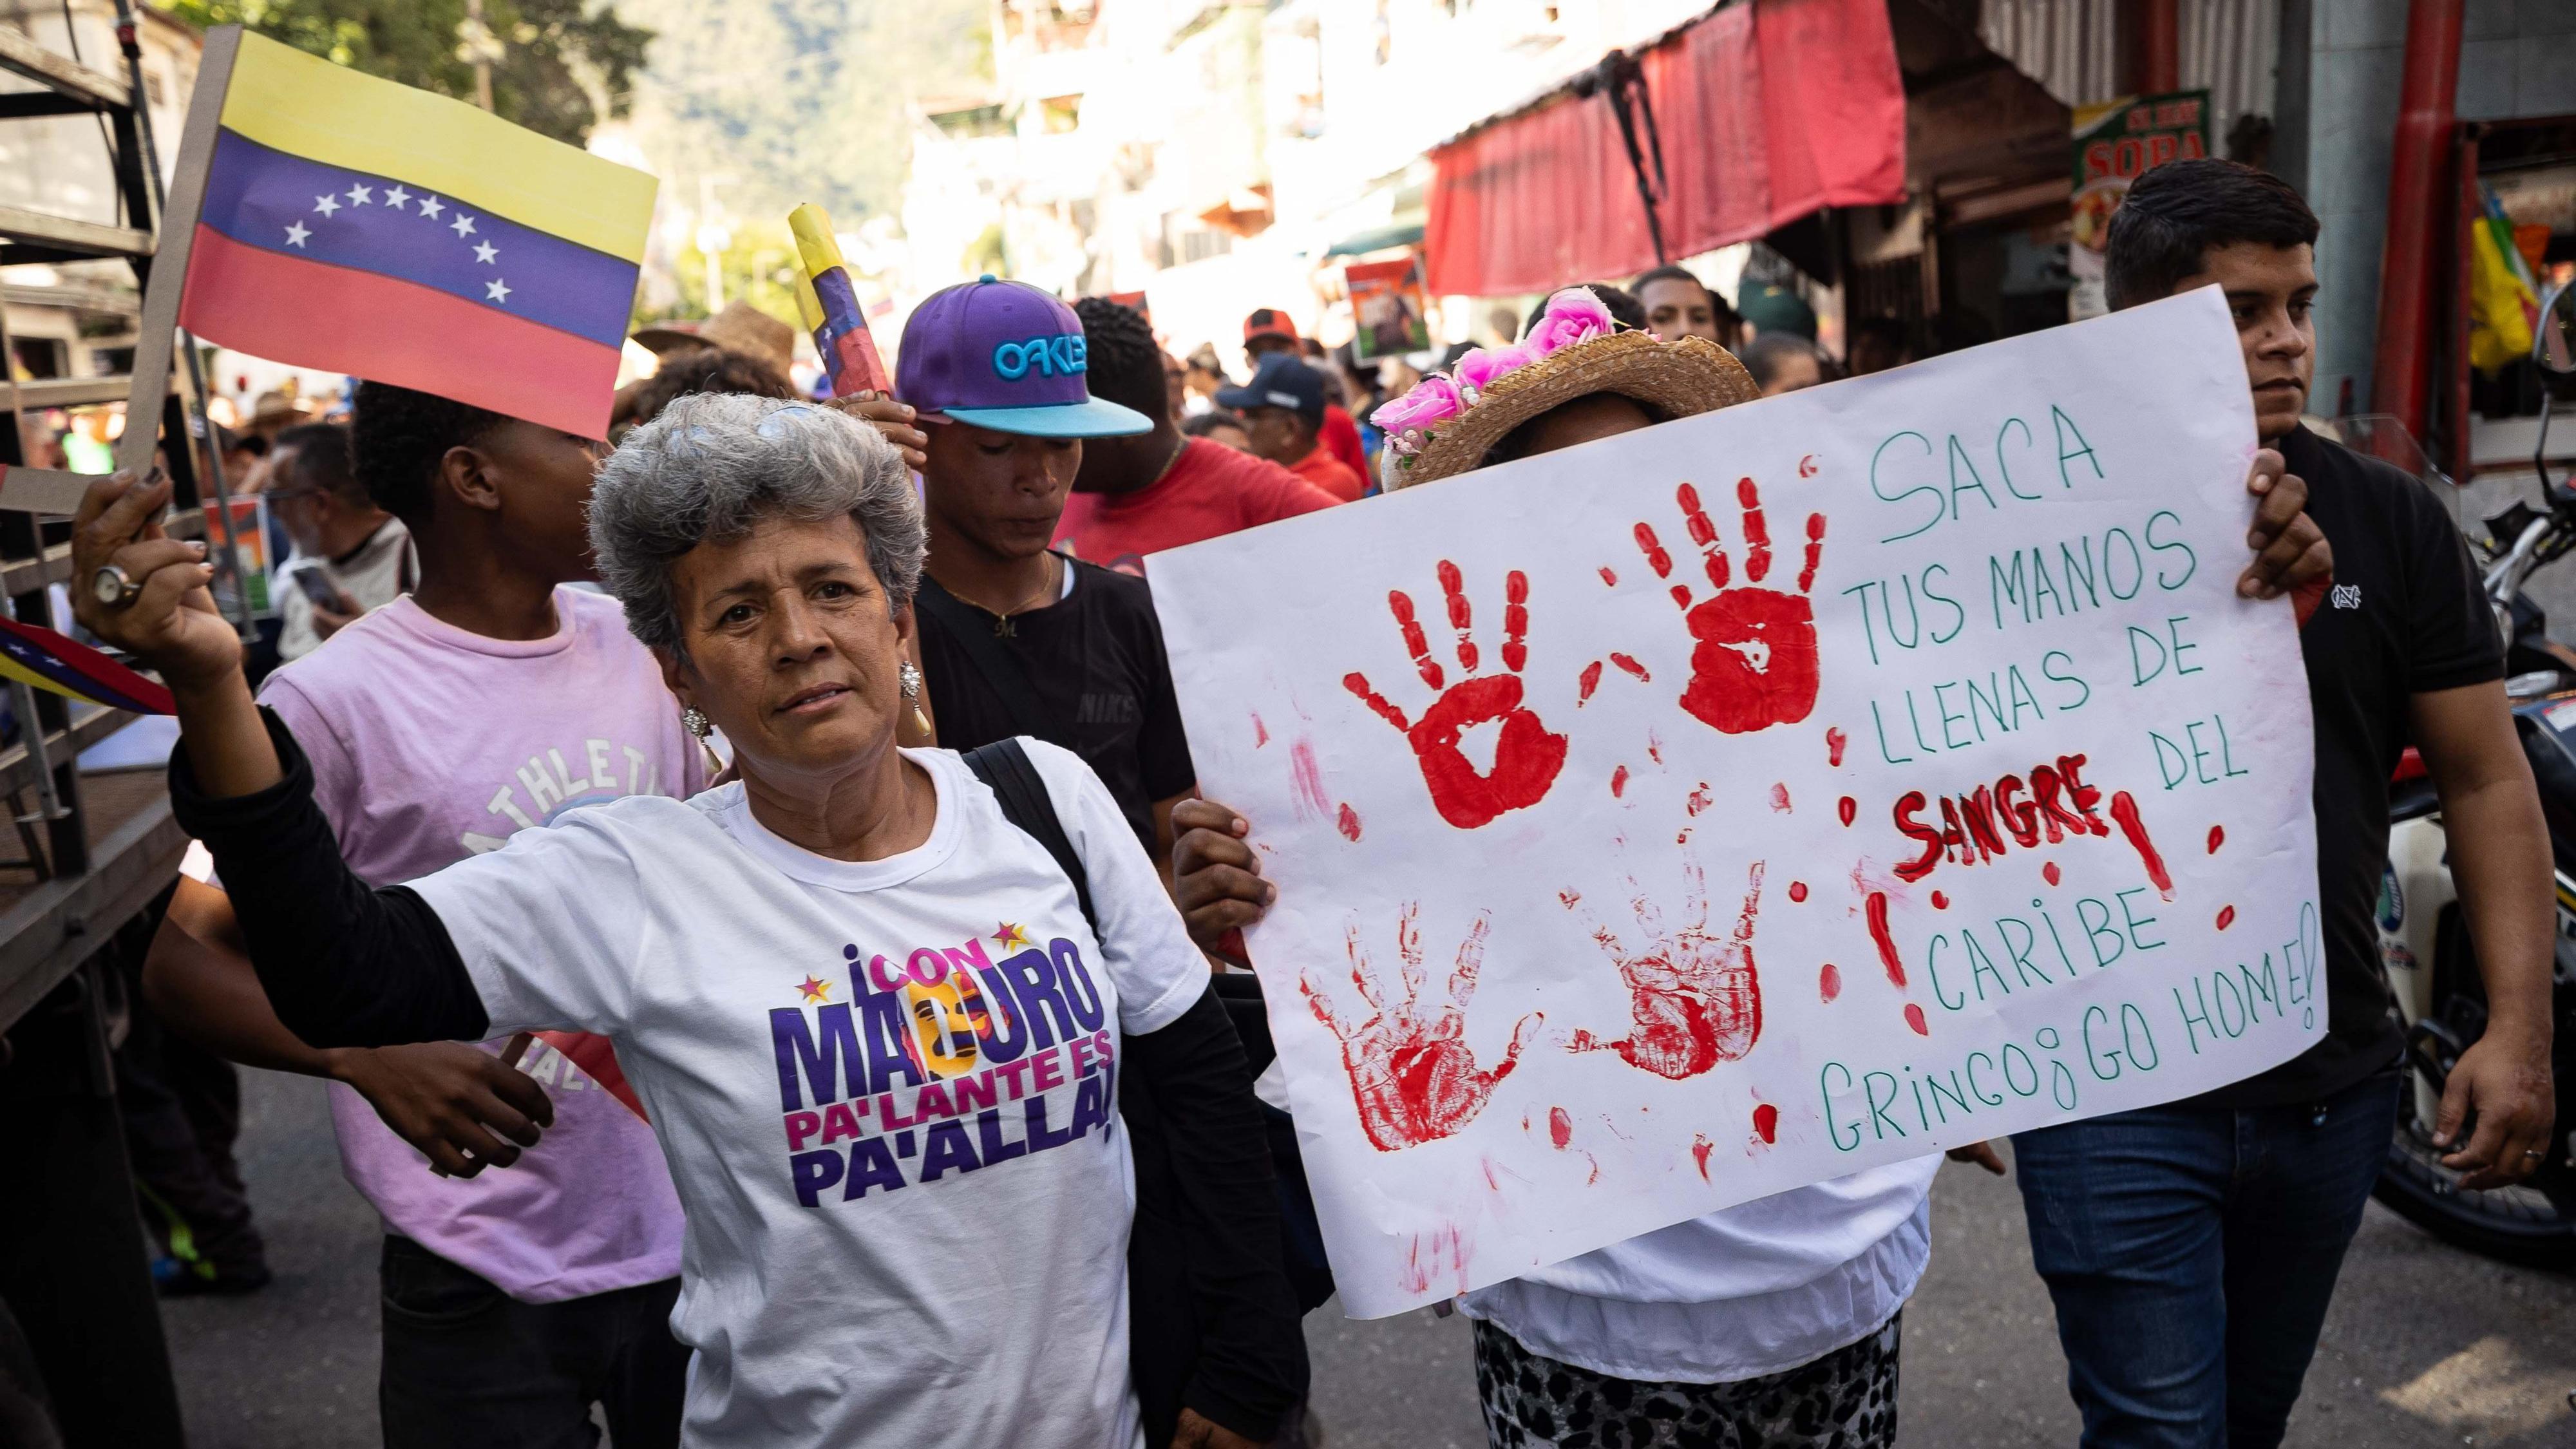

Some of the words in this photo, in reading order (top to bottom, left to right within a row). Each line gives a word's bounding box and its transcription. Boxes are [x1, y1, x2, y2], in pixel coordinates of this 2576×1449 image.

[2085, 131, 2205, 183] SOPA
[1871, 404, 2103, 544] SACA
[1841, 564, 1964, 665] TUS
[1990, 511, 2196, 630] MANOS
[1075, 692, 1136, 723] NIKE
[1871, 650, 2090, 764] LLENAS
[2127, 616, 2204, 687] DE
[1893, 753, 2110, 883] SANGRE
[2148, 714, 2249, 790] DEL
[768, 938, 1104, 1113] MADURO
[2173, 902, 2317, 1054] HOME!
[783, 1047, 1064, 1152] PA'LANTE
[1069, 1030, 1113, 1080] ES
[790, 1060, 1115, 1208] PA'ALLA!
